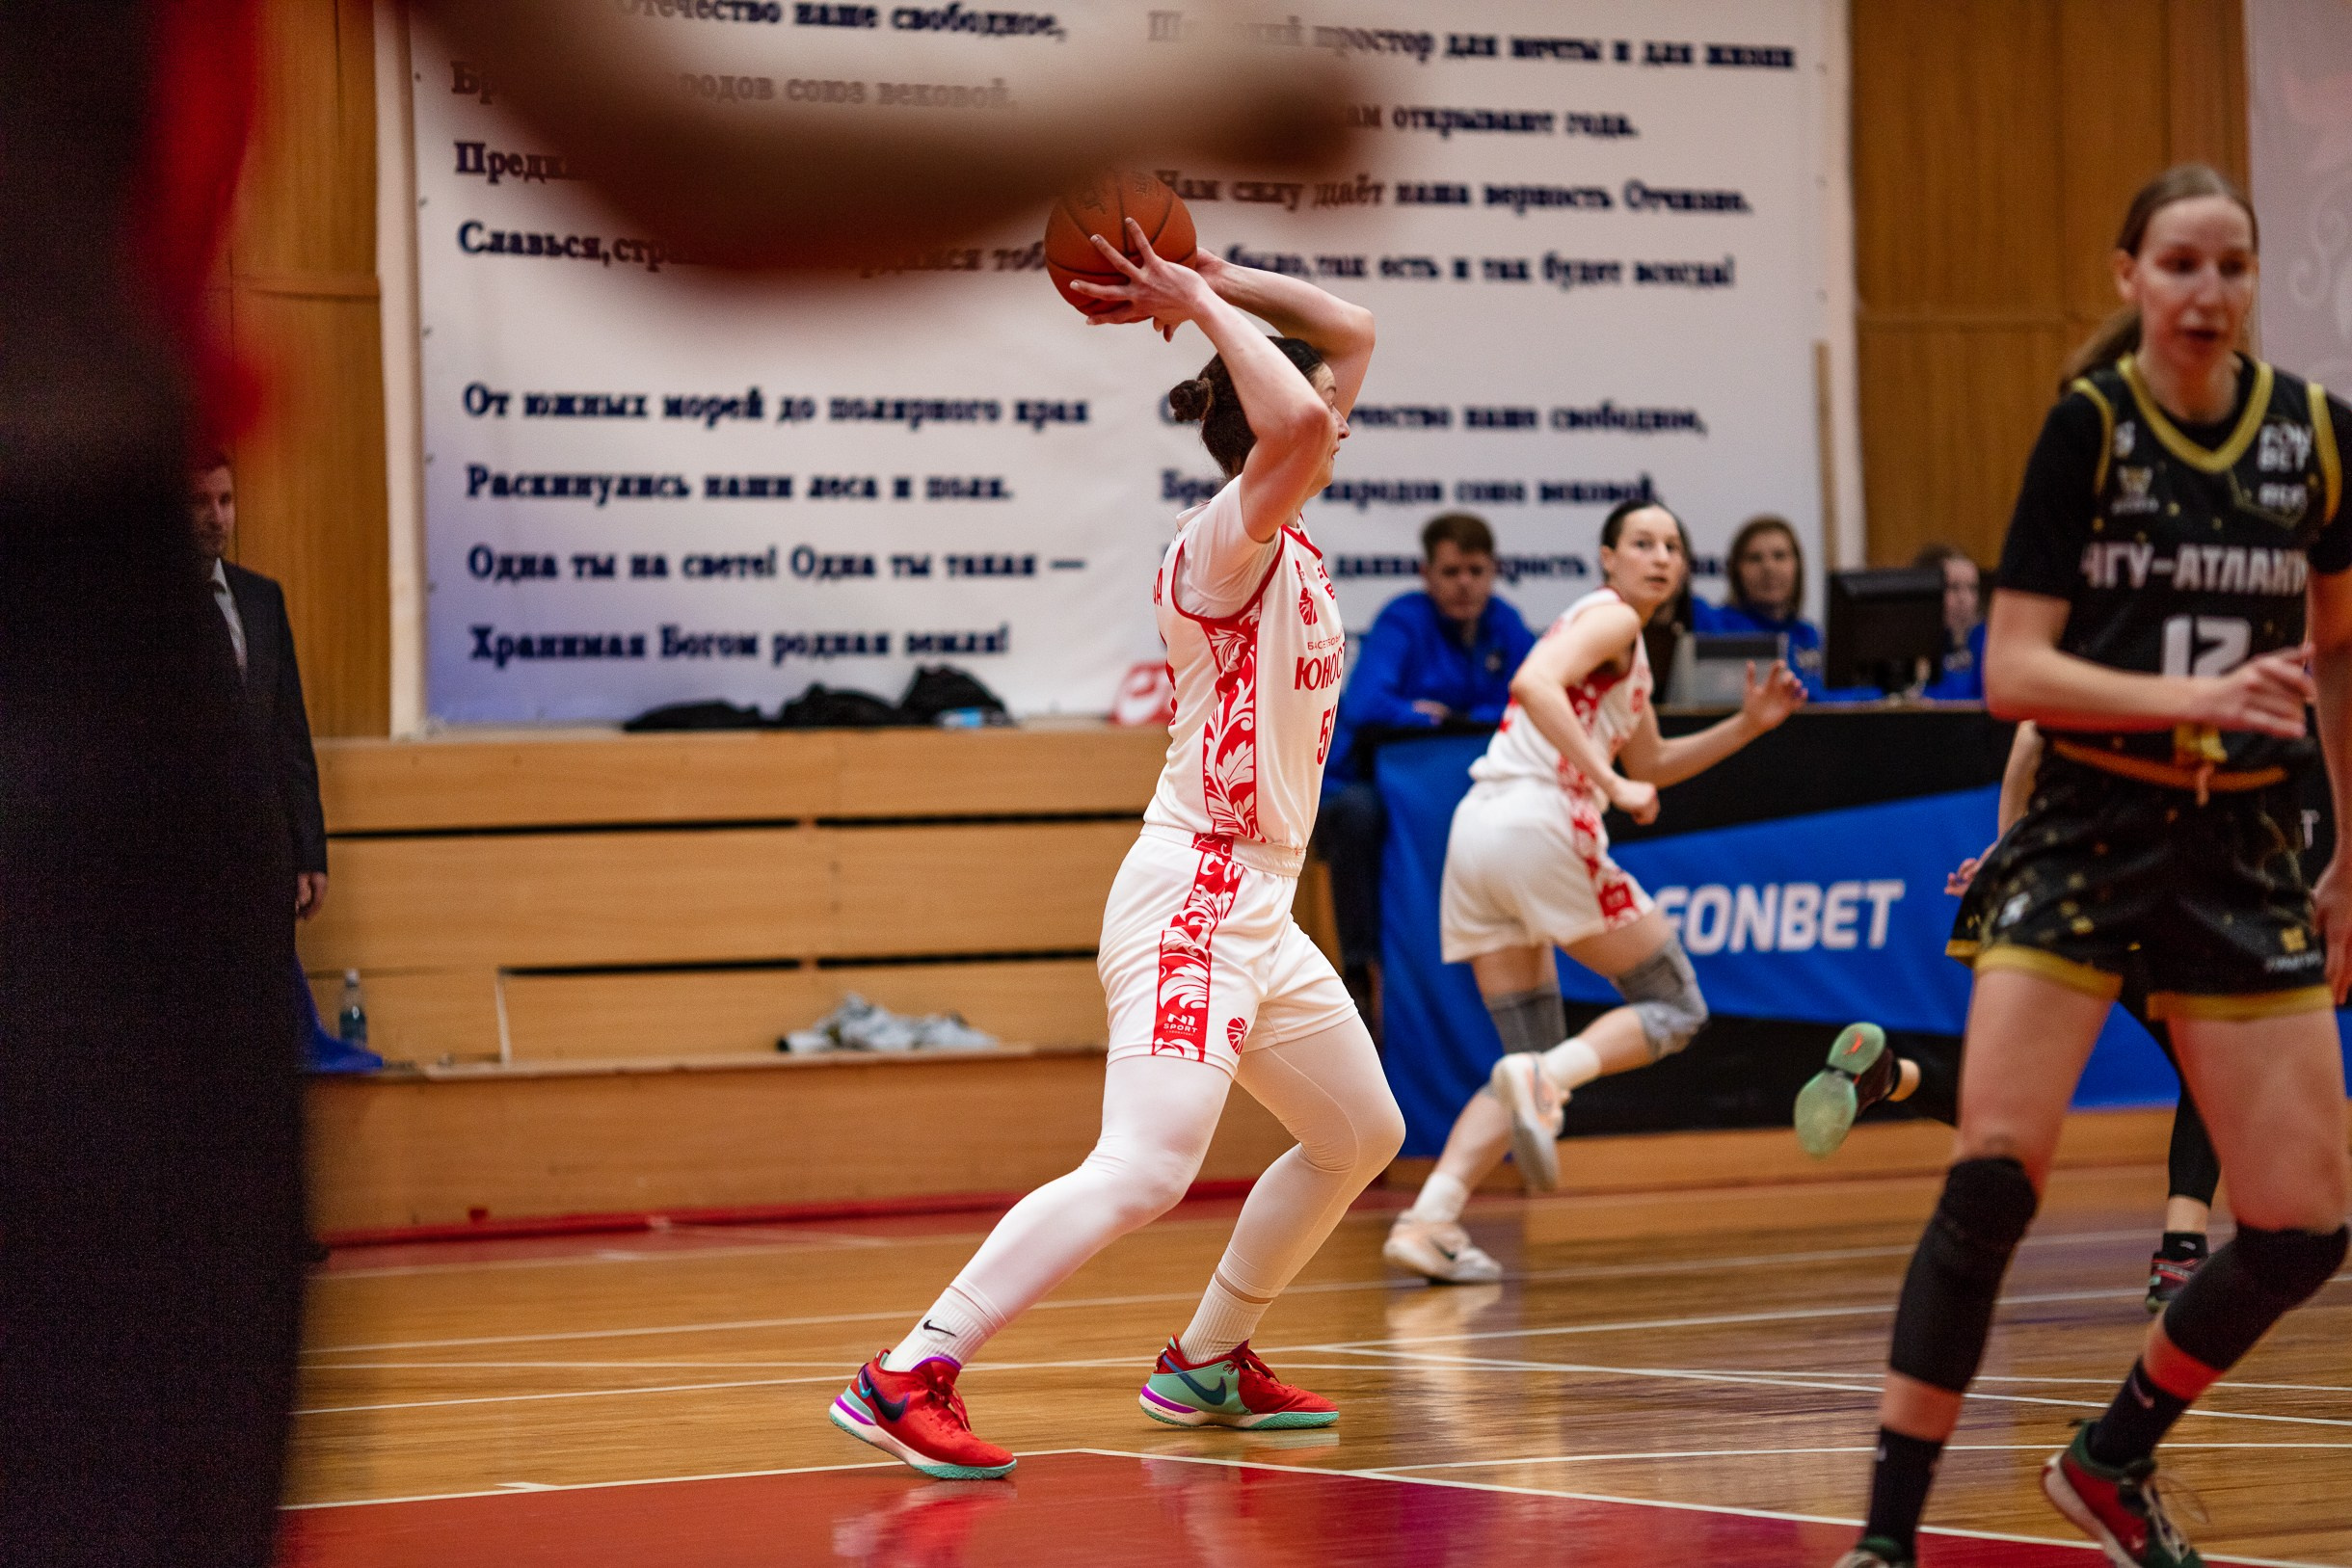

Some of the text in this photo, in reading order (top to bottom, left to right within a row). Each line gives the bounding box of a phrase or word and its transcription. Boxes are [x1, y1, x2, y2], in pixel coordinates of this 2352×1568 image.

[794, 3, 876, 29] наше
[891, 4, 1066, 41] свободное,
[1446, 33, 1498, 60] для
[1614, 40, 1630, 64] и
[1644, 41, 1694, 67] для
[677, 72, 775, 104] родов
[785, 77, 866, 105] союз
[1350, 104, 1641, 139] ам открывают года.
[453, 142, 578, 184] Предк
[1396, 179, 1470, 206] наша
[1484, 181, 1614, 217] верность
[1380, 254, 1439, 279] есть
[1452, 255, 1470, 280] и
[1482, 256, 1530, 280] так
[1542, 249, 1621, 292] будет
[1633, 253, 1734, 287] всегда!
[464, 382, 1089, 432] От южных морей до полярного края
[1349, 398, 1709, 437] чество наше свободное,
[467, 463, 1012, 507] Раскинулись наши леса и поля.
[1456, 481, 1526, 503] союз
[468, 543, 558, 584] Одна
[572, 552, 616, 578] ты
[629, 553, 670, 578] на
[681, 545, 777, 579] свете!
[789, 544, 875, 585] Одна
[889, 553, 931, 578] ты
[944, 553, 1036, 578] такая
[468, 622, 1009, 670] Хранимая Богом родная земля!
[1294, 642, 1346, 691] ЮНОС
[1317, 704, 1337, 765] 5
[1653, 879, 1906, 956] FONBET
[1163, 1023, 1198, 1033] SPORT
